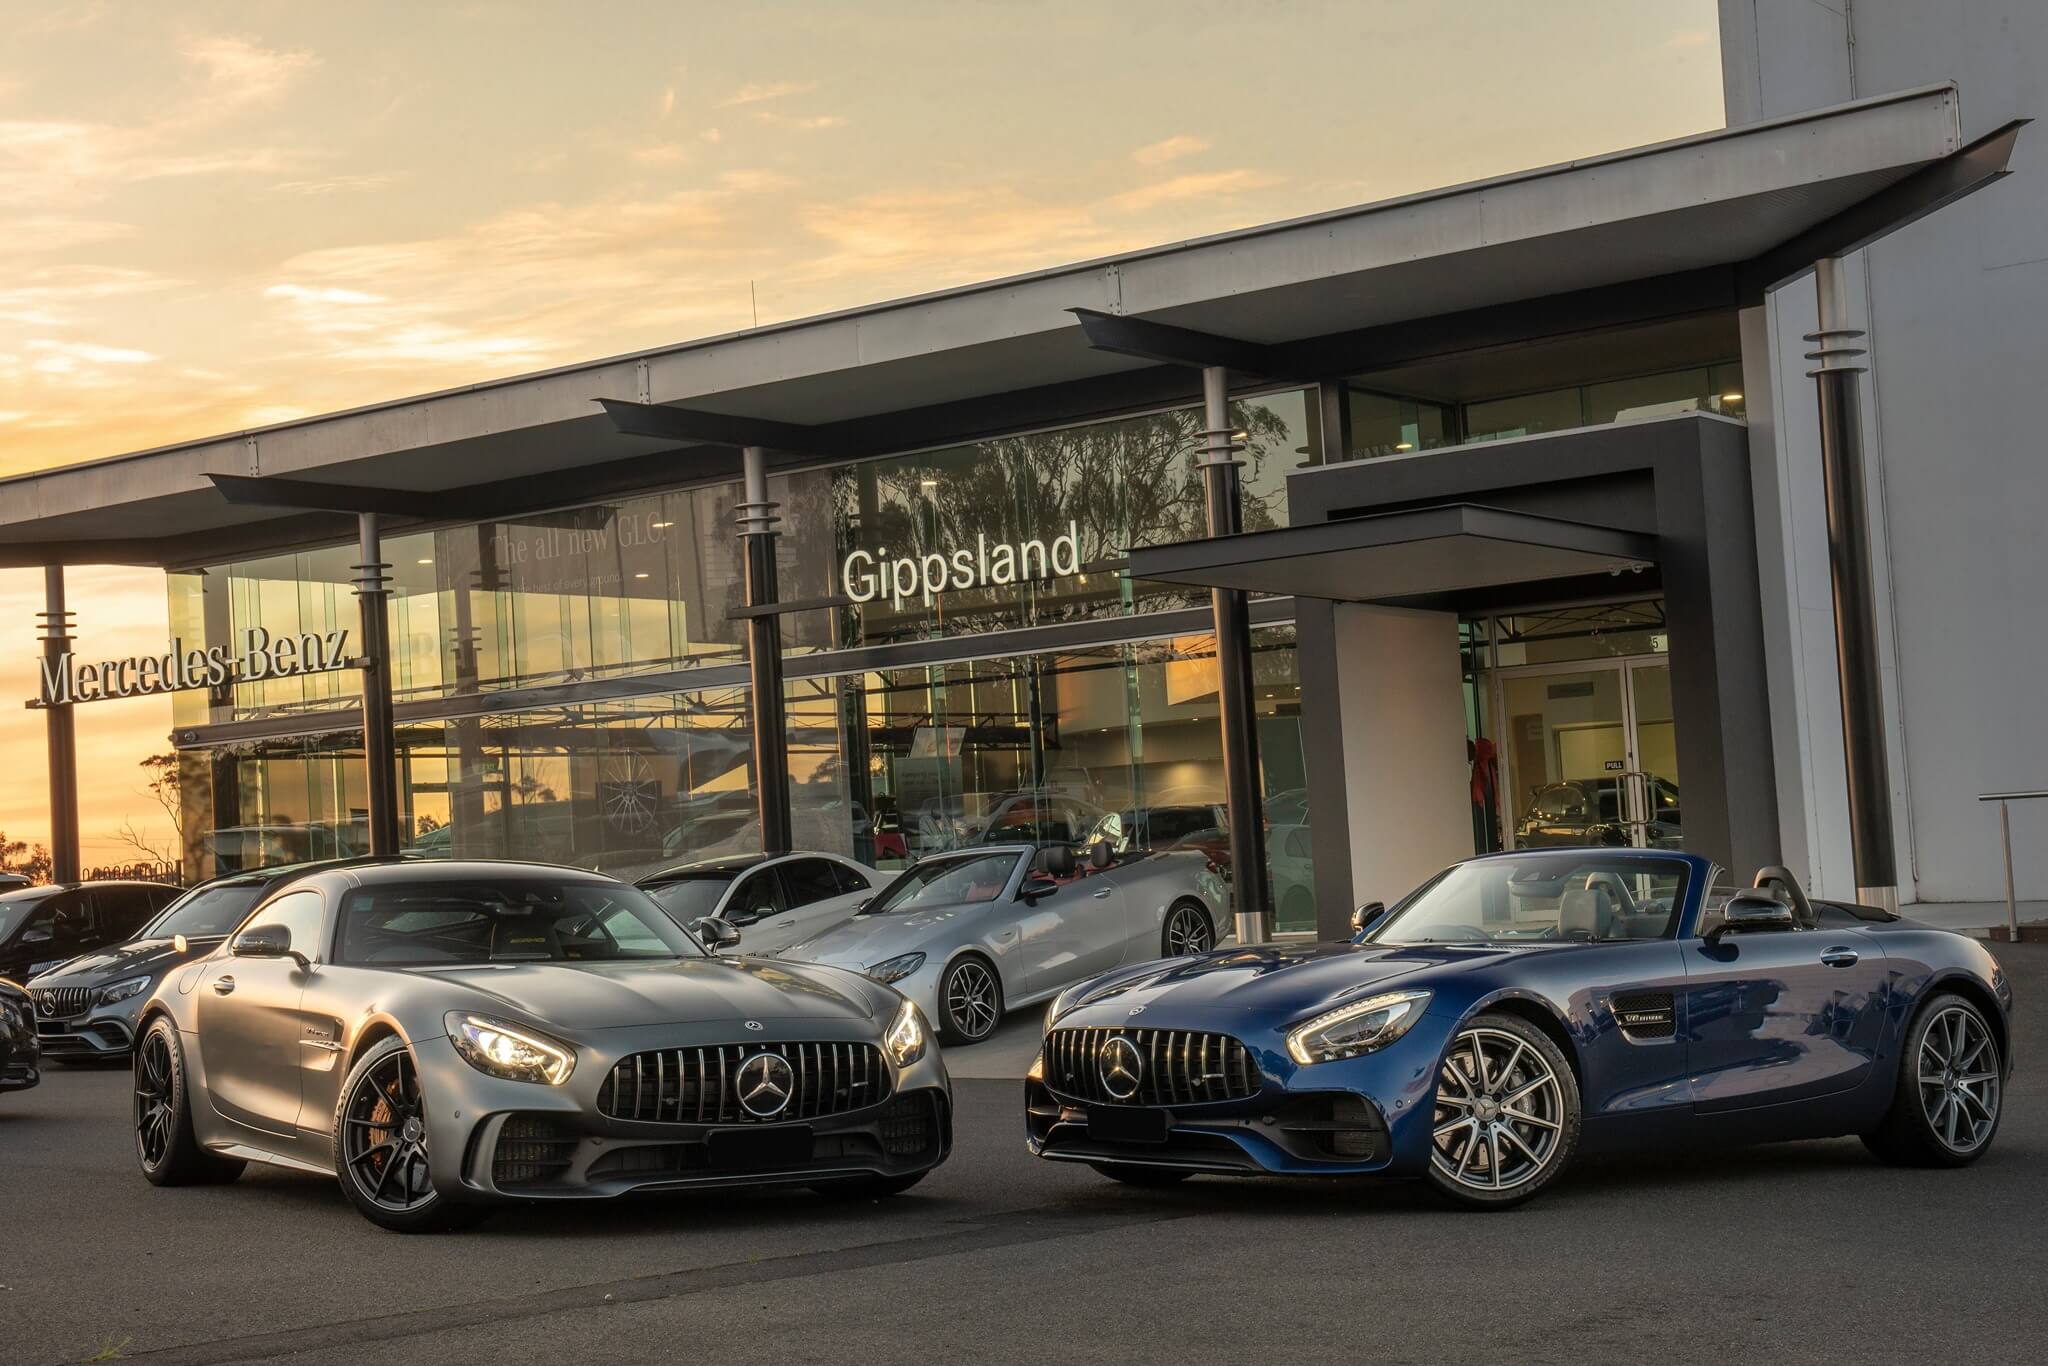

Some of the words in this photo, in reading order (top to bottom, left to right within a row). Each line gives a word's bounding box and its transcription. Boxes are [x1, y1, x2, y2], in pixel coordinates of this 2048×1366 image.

[490, 534, 528, 566] The
[535, 527, 561, 560] all
[568, 528, 609, 555] new
[618, 512, 667, 548] GLC.
[843, 520, 1080, 611] Gippsland
[36, 626, 349, 707] Mercedes-Benz
[1606, 761, 1622, 769] PULL
